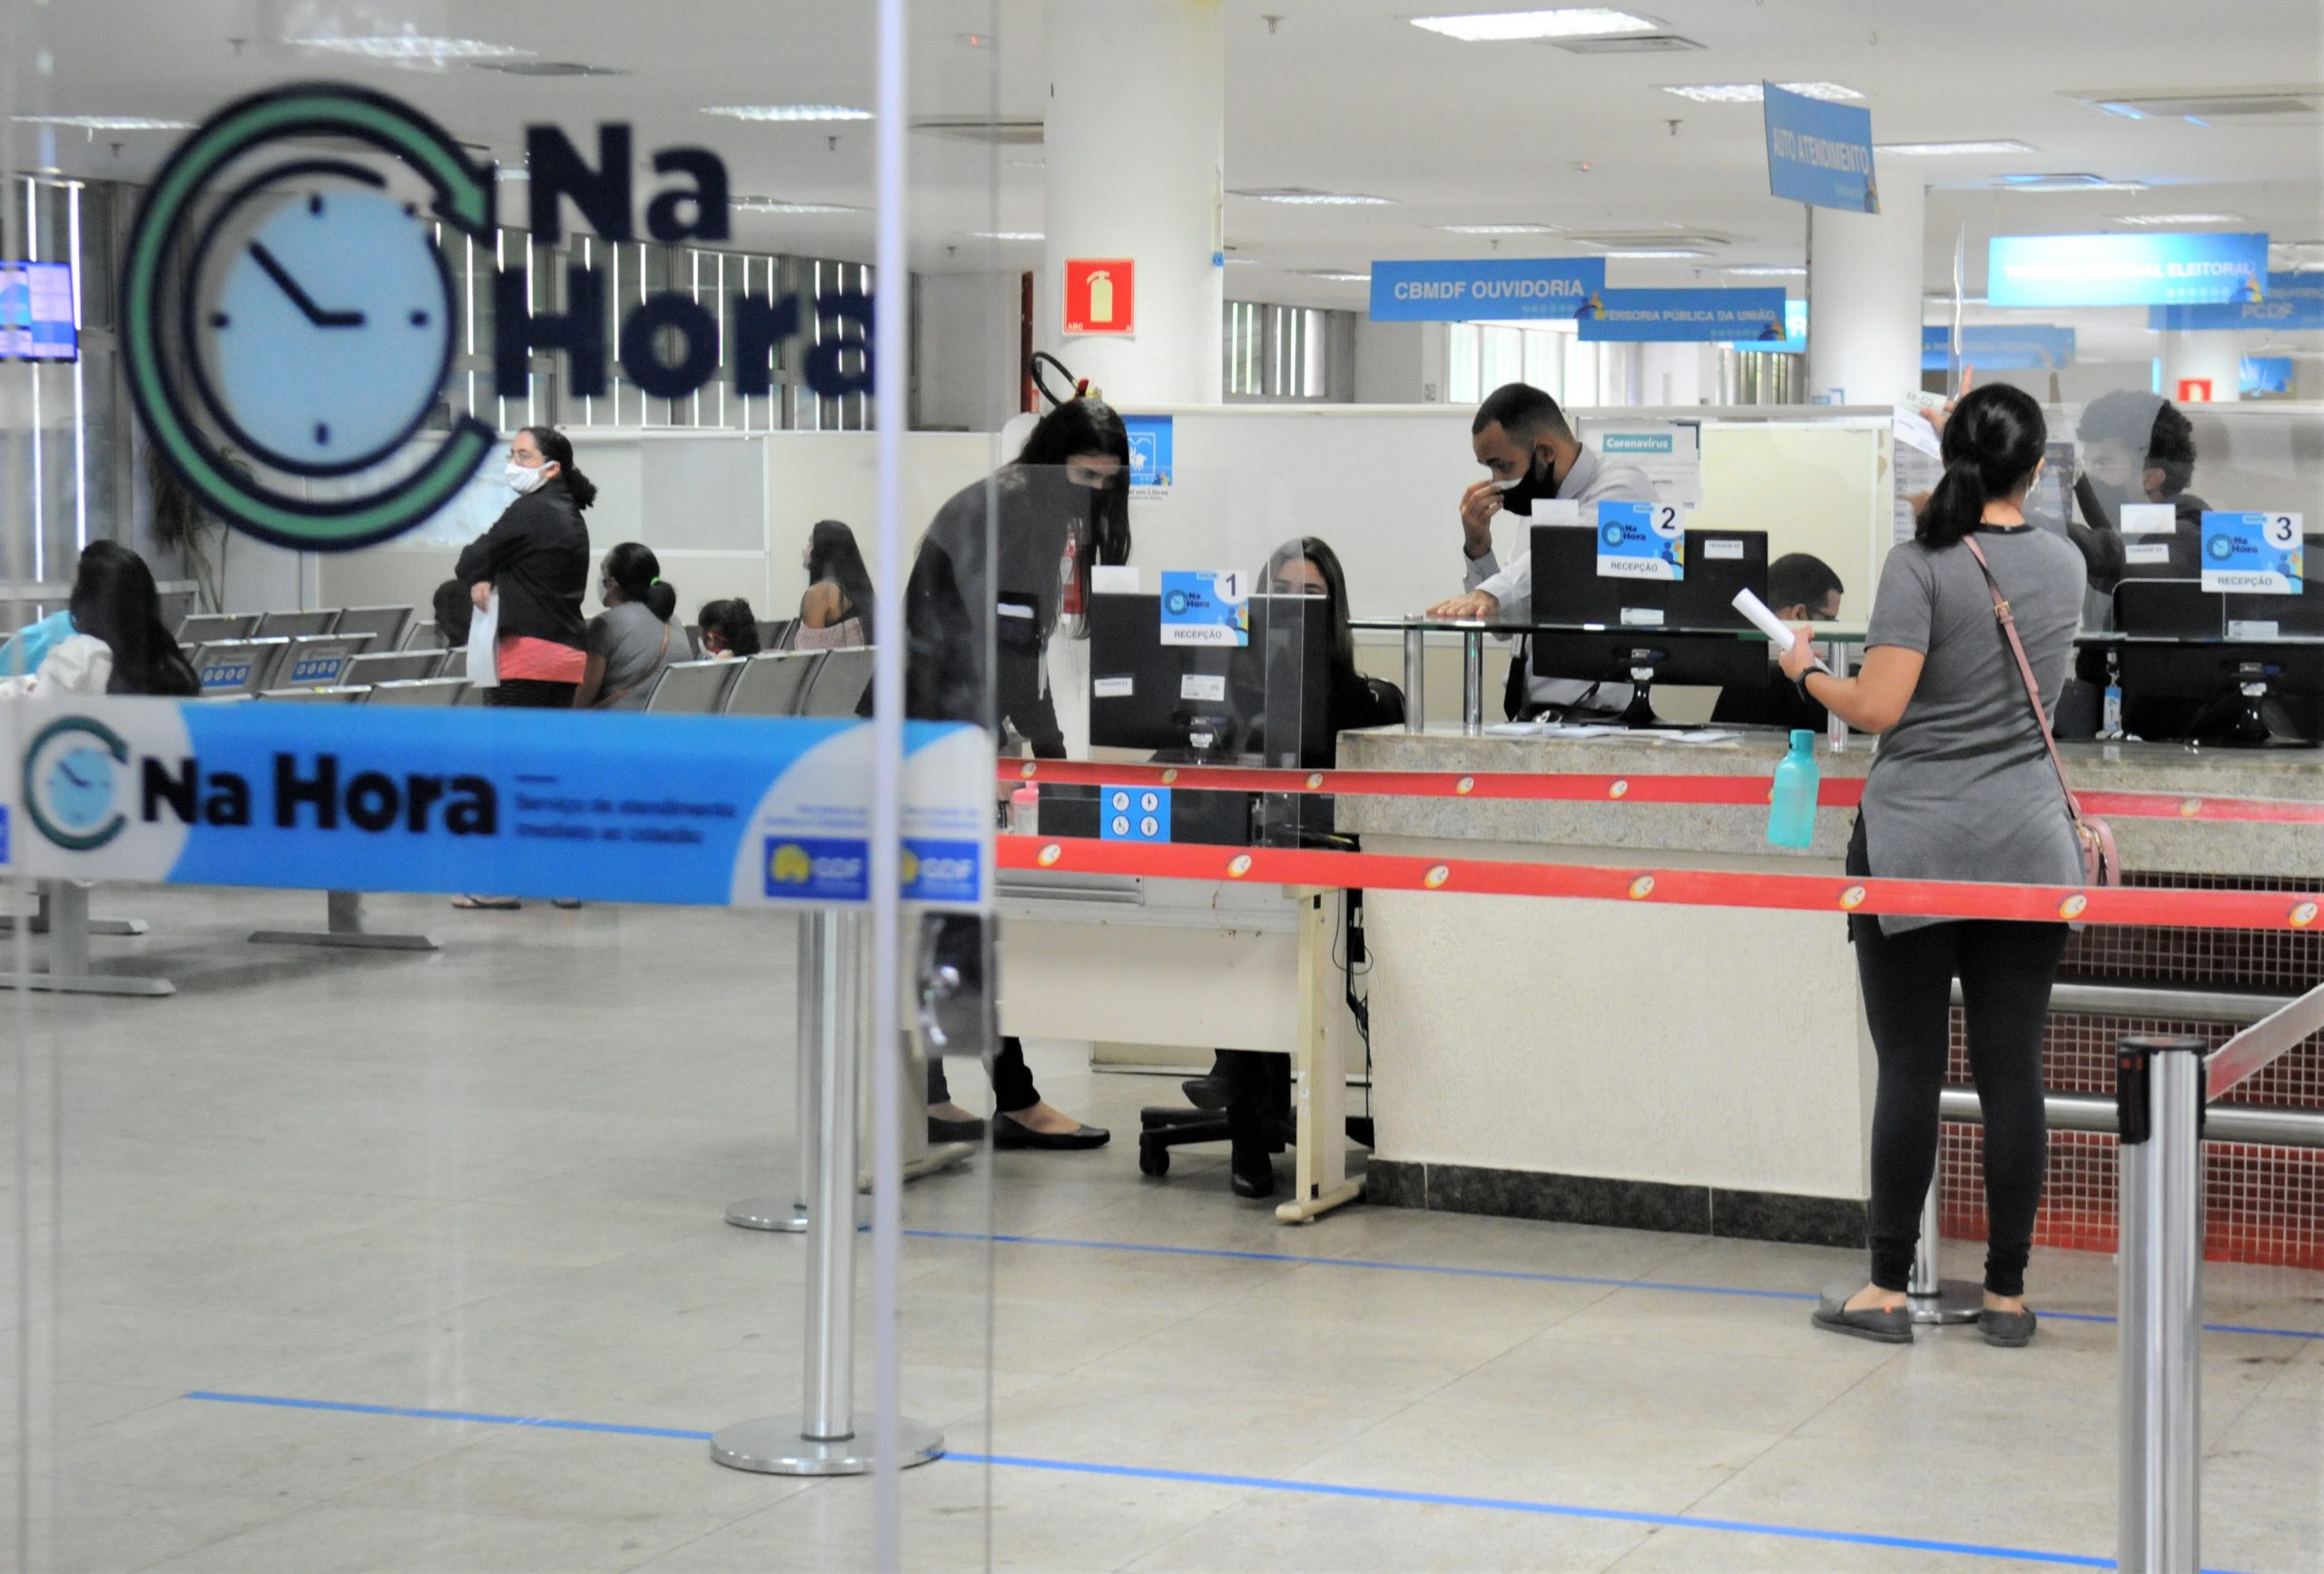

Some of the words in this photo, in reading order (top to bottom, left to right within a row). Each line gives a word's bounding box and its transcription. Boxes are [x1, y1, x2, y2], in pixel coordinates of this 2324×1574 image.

[526, 123, 732, 243] Na
[1393, 280, 1466, 300] CBMDF
[1471, 279, 1584, 300] OUVIDORIA
[495, 265, 876, 398] Hora
[1606, 437, 1669, 448] Coronavírus
[1660, 507, 1676, 530] 2
[2276, 516, 2292, 542] 3
[1622, 531, 1647, 541] Hora
[2230, 545, 2259, 554] Hora
[1610, 560, 1659, 574] RECEPÇÃO
[1226, 574, 1236, 596] 1
[2217, 575, 2273, 586] RECEPÇÃO
[1173, 628, 1222, 640] RECEPÇÃO
[140, 754, 252, 827] Na
[272, 752, 500, 836] Hora
